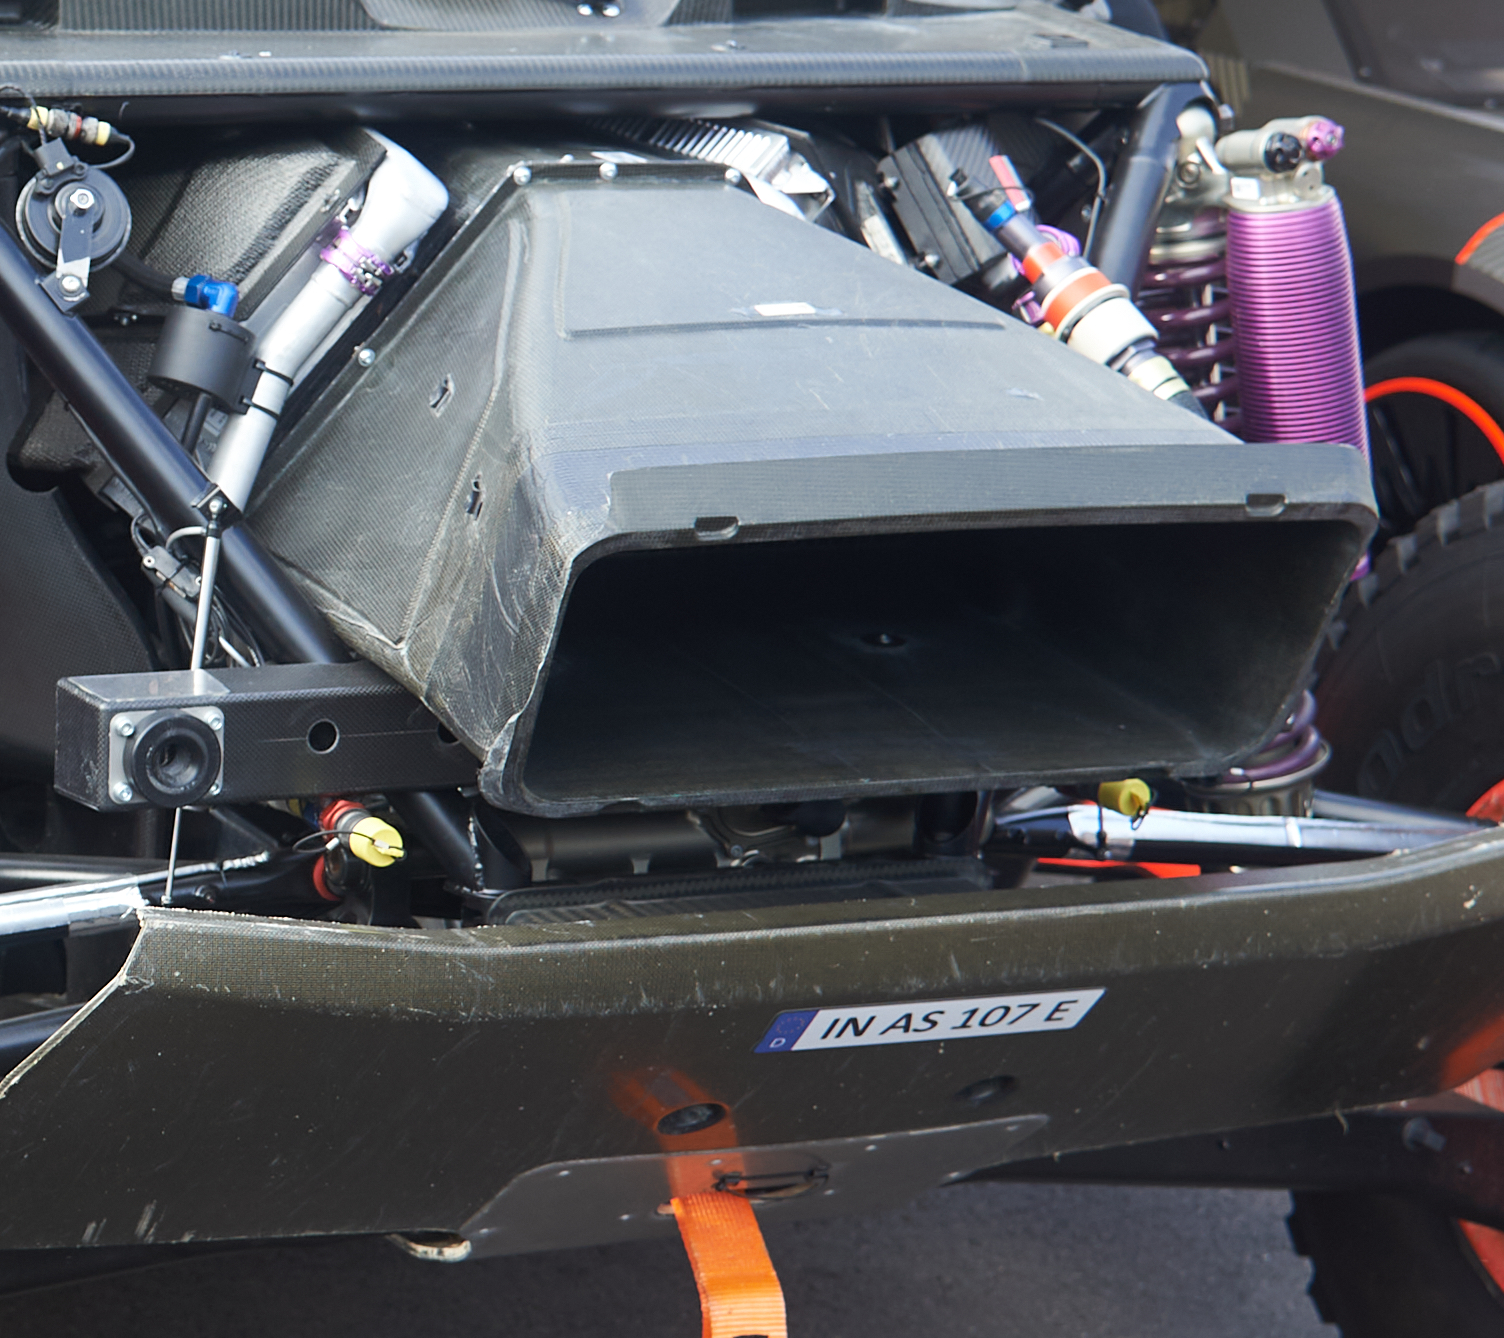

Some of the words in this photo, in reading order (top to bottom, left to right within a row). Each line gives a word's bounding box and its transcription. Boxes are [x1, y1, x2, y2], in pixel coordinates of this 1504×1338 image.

[770, 1036, 786, 1049] D
[819, 1015, 877, 1041] IN
[878, 1010, 945, 1036] AS
[949, 1002, 1042, 1031] 107
[1043, 999, 1079, 1023] E
